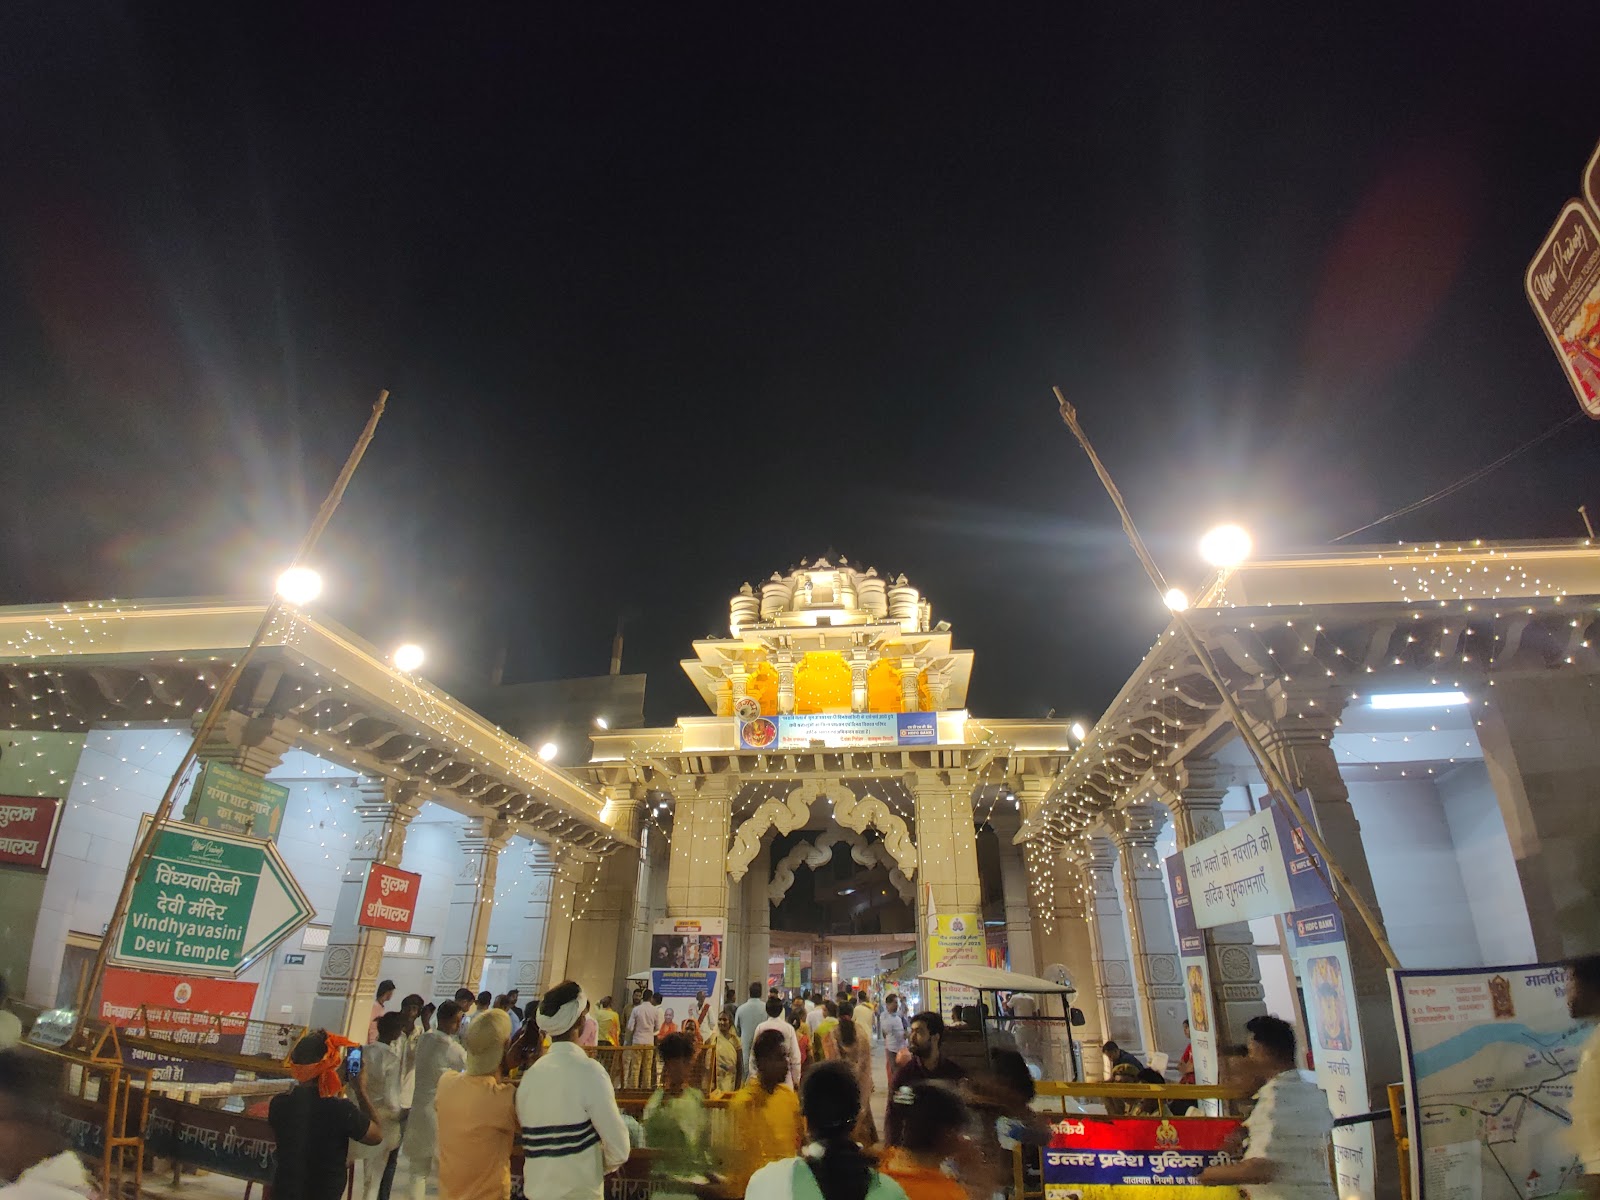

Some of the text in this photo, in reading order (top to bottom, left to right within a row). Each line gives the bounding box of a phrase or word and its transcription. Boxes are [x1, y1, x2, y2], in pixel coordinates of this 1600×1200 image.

[207, 786, 229, 803] गंगा
[230, 794, 249, 809] घाट
[217, 806, 233, 820] का
[1190, 856, 1204, 878] सभी
[1220, 845, 1231, 868] को
[1231, 833, 1259, 863] नवरात्रि
[1259, 826, 1273, 853] की
[155, 863, 242, 896] विंध्यवासिनी
[380, 874, 410, 897] सुलभ
[156, 890, 228, 921] देवी मंदिर
[367, 898, 410, 923] शौचालय
[132, 912, 243, 941] Vindhyavasini
[1305, 918, 1334, 931] HDFC BANK
[134, 936, 230, 963] Devi Temple
[1525, 968, 1568, 987] मानचि
[178, 1122, 220, 1157] जनपद
[223, 1126, 278, 1169] मीरजापुर
[1047, 1152, 1096, 1167] उत्तर
[1098, 1151, 1144, 1169] प्रदेश
[1149, 1150, 1204, 1173] पुलिस
[1122, 1175, 1151, 1185] यातायात
